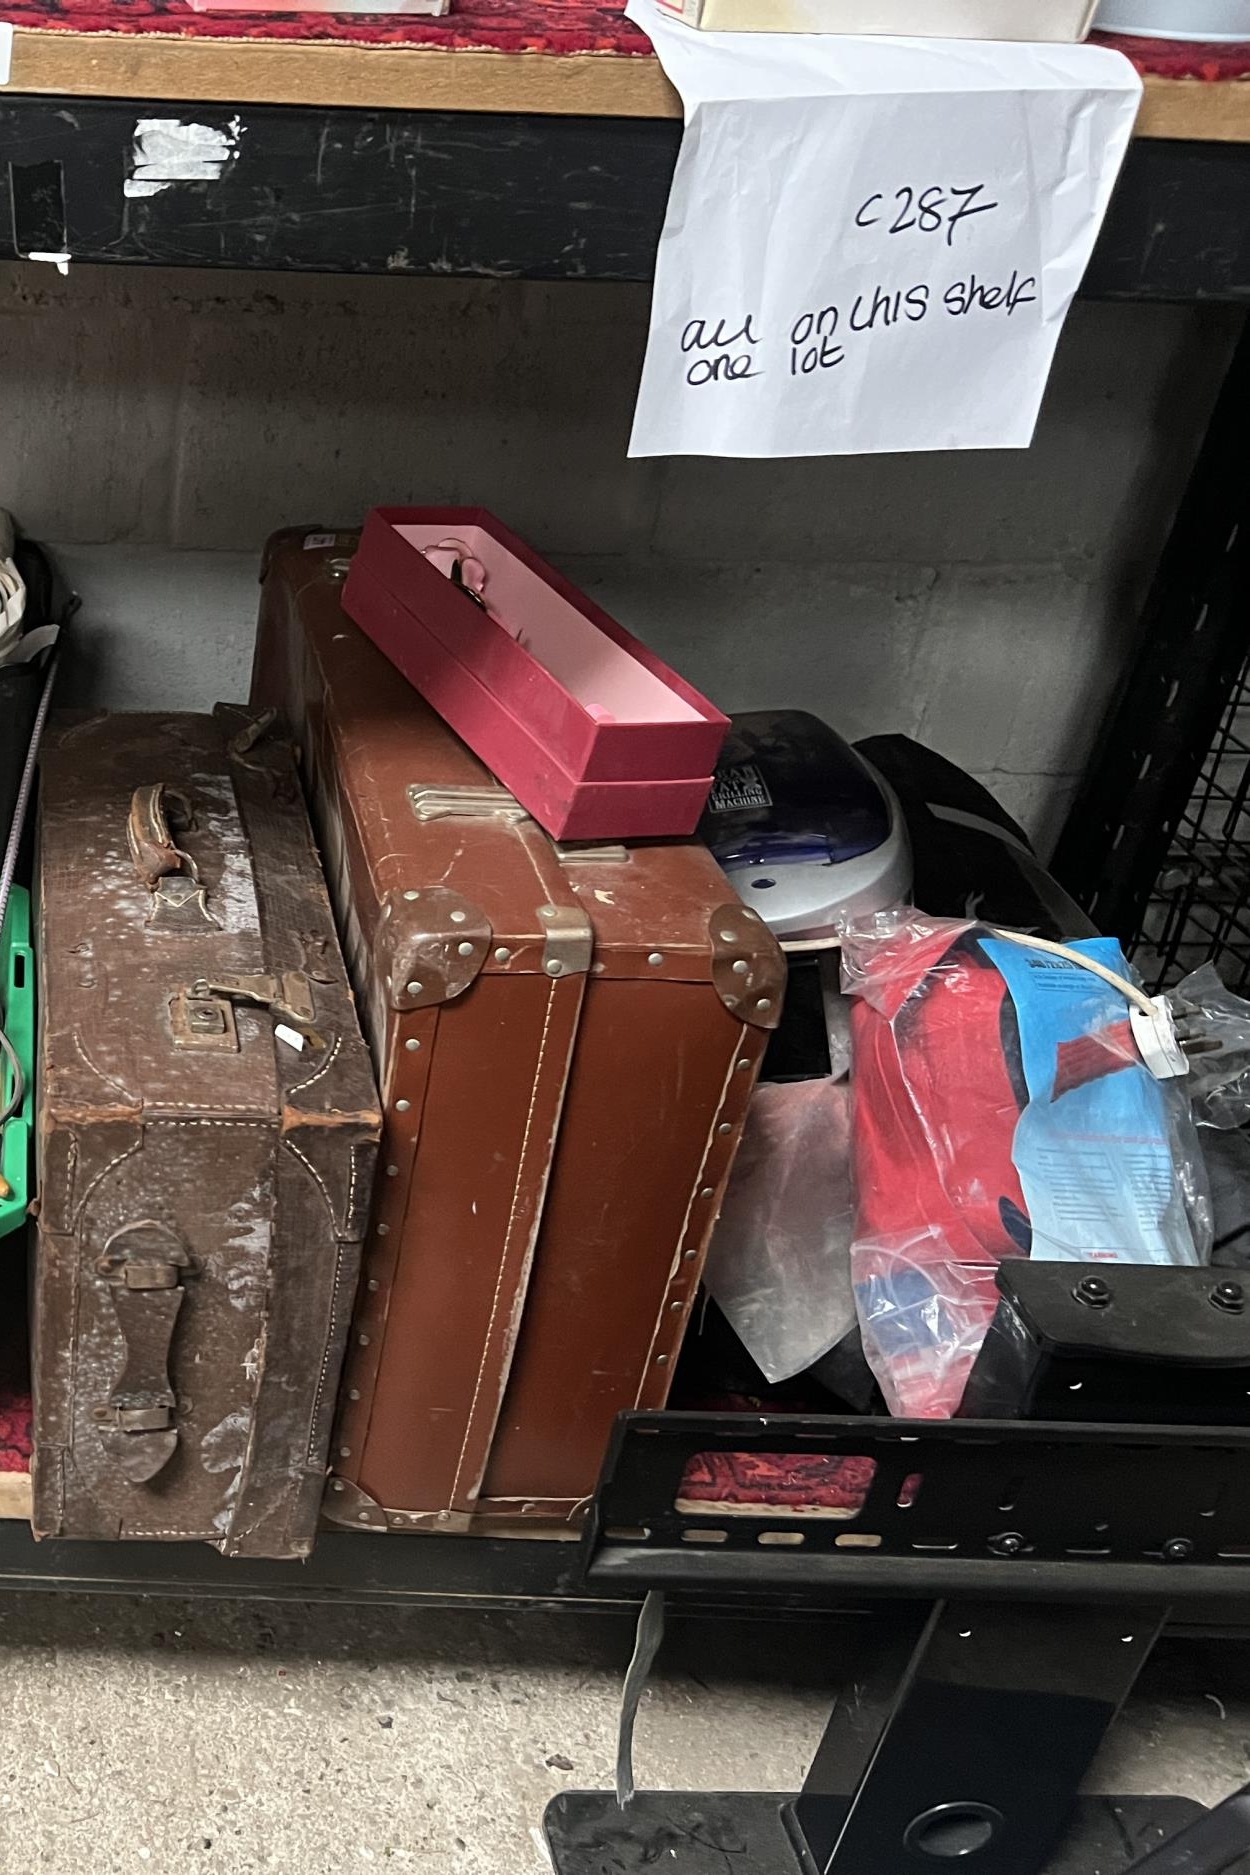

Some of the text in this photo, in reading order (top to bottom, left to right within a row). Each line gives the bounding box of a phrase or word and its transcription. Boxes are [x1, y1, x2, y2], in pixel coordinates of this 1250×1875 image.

[790, 307, 837, 343] on
[687, 336, 846, 386] one lot
[715, 796, 766, 809] MACHINE
